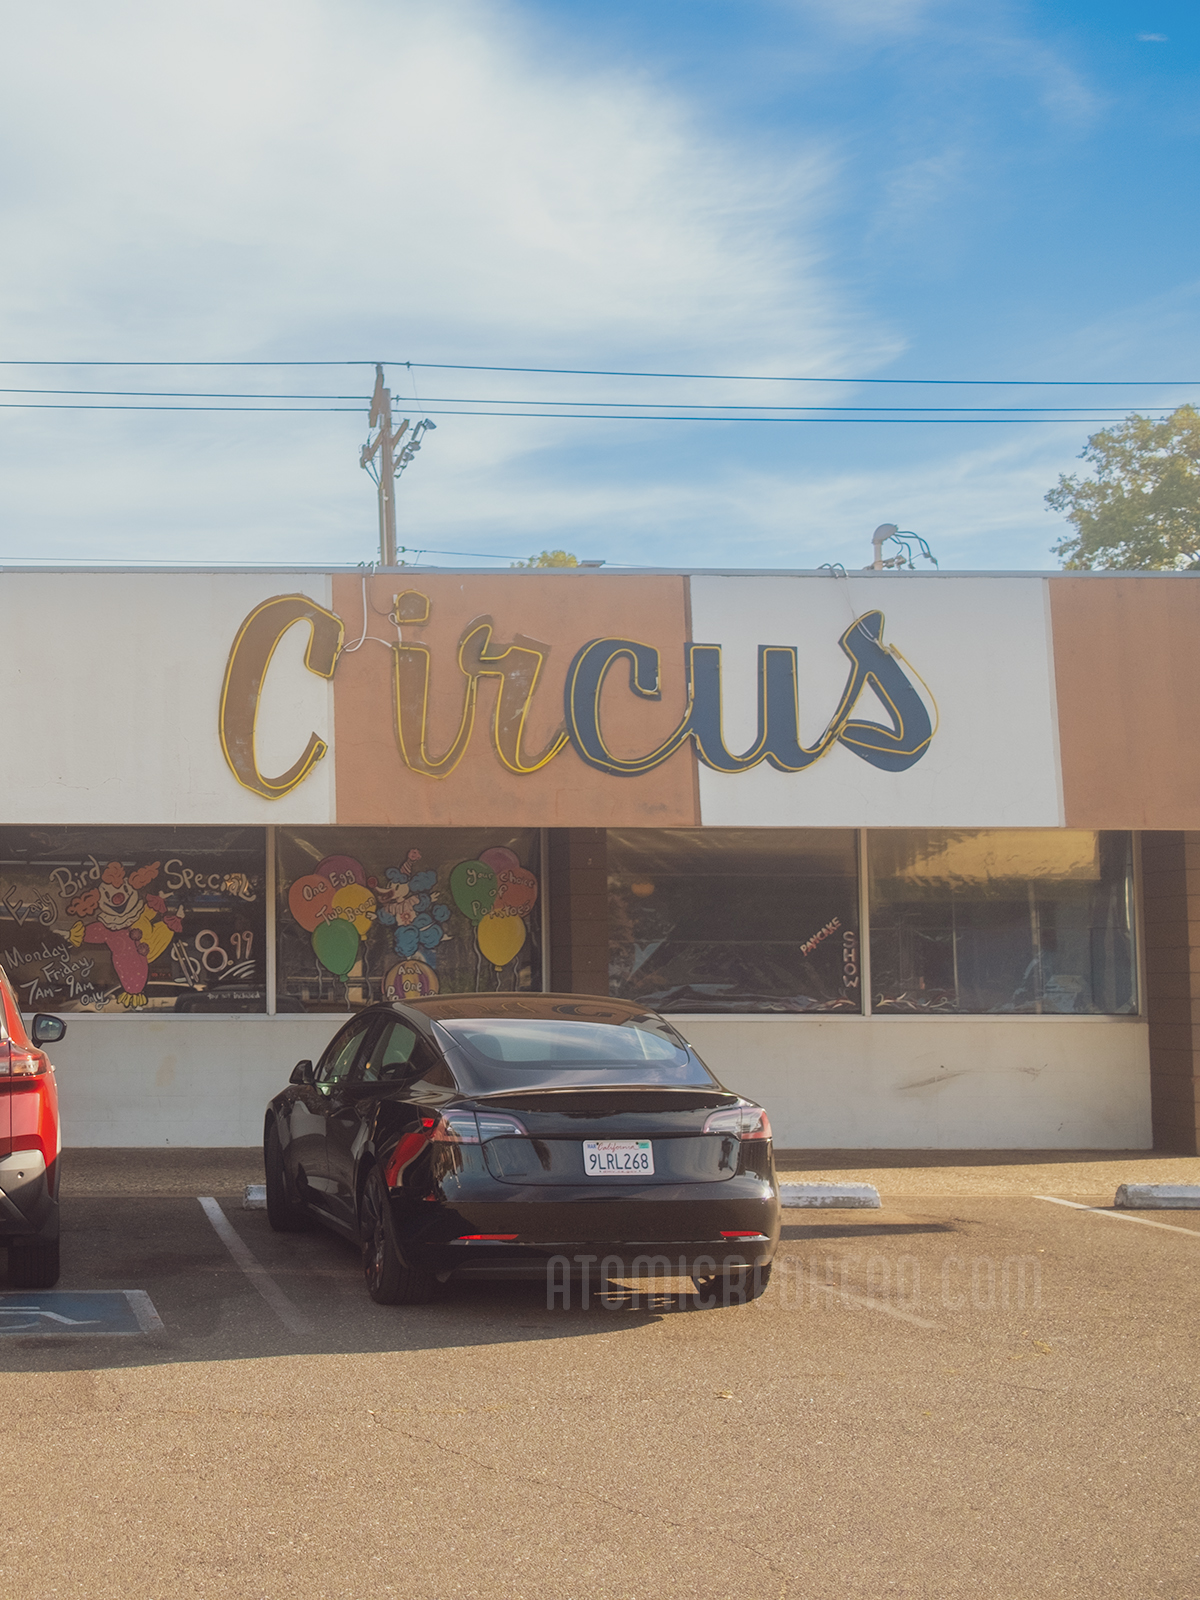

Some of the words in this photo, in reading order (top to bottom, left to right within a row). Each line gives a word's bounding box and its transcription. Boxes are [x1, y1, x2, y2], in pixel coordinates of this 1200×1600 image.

[218, 588, 939, 801] Circus
[2, 885, 58, 926] Early
[49, 854, 101, 898] Bird
[302, 882, 327, 901] One
[329, 869, 356, 887] Egg
[489, 884, 508, 899] of
[315, 905, 342, 926] Two
[344, 897, 375, 922] Bacon
[799, 916, 841, 957] PANCAKE
[42, 957, 94, 982] Friday
[171, 929, 253, 987] $8.99
[398, 962, 422, 975] And
[842, 931, 859, 988] SHOW
[403, 980, 423, 992] One
[81, 991, 110, 1010] Only
[597, 1142, 638, 1152] California
[589, 1153, 649, 1170] 9LRL268
